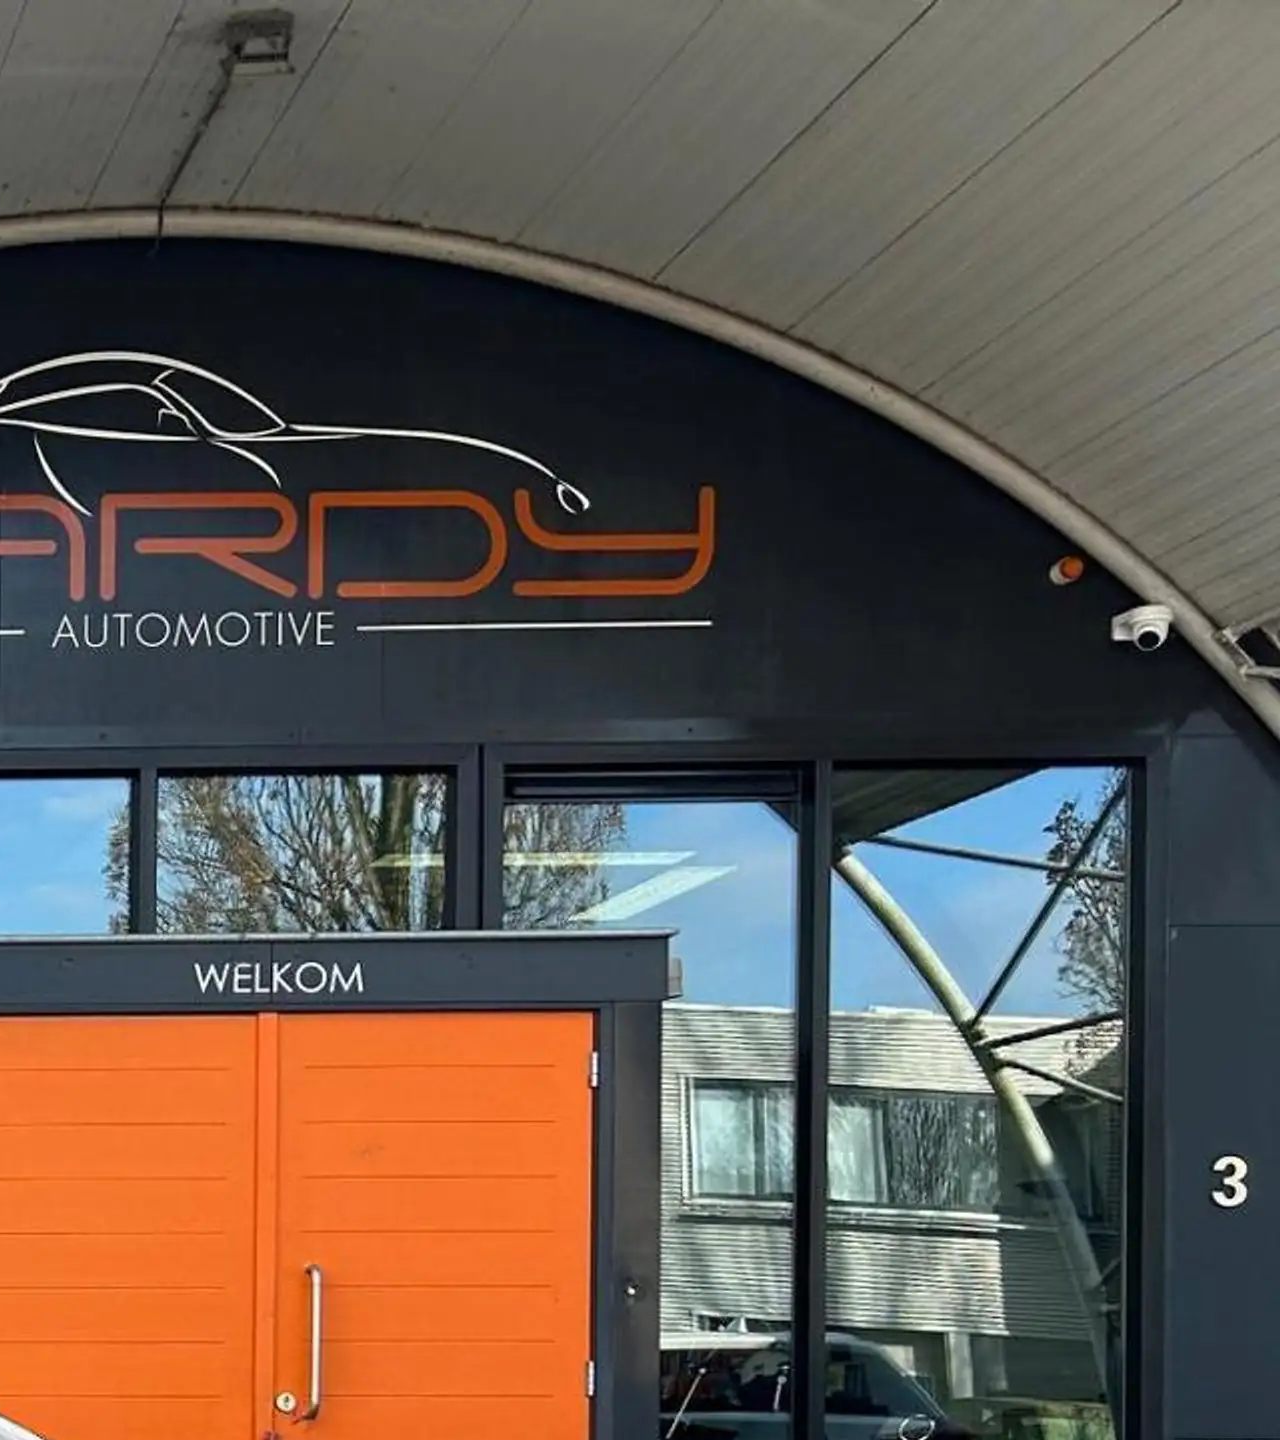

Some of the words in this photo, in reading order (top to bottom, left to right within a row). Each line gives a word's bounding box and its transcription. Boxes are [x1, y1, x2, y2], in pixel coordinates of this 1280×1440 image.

[50, 610, 335, 649] AUTOMOTIVE
[193, 960, 365, 995] WELKOM
[1211, 1154, 1249, 1208] 3
